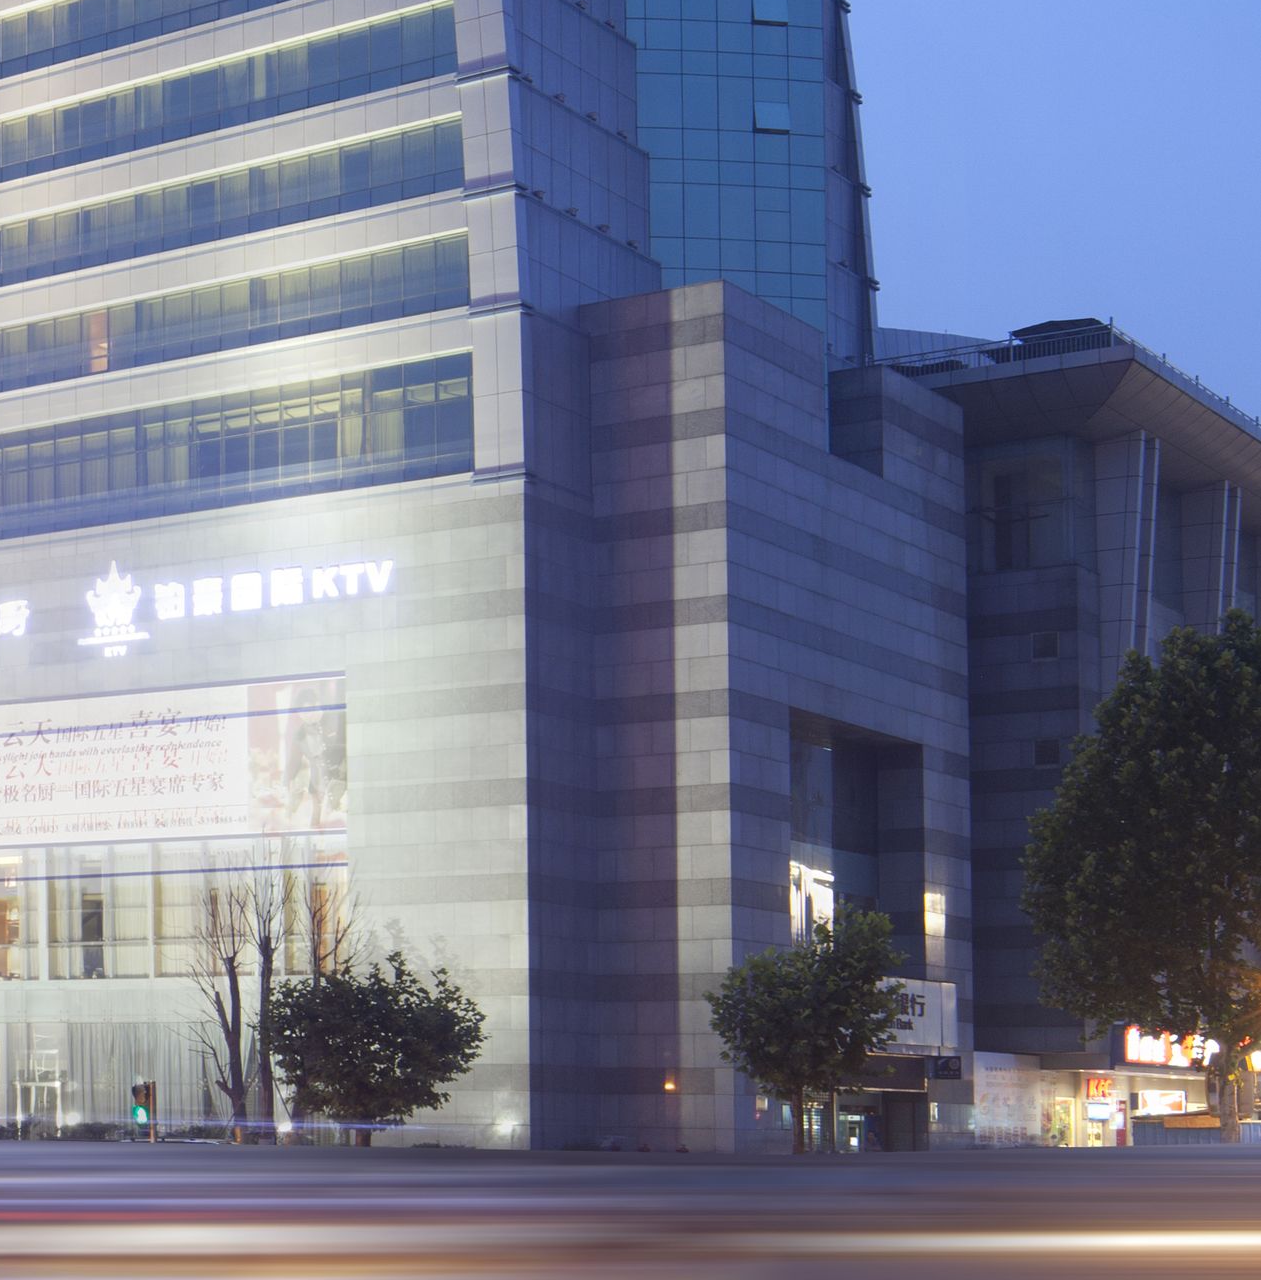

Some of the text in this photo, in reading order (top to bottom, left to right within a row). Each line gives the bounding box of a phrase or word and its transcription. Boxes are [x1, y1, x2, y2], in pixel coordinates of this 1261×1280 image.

[103, 645, 128, 658] KTV
[49, 748, 77, 758] hands
[79, 746, 98, 756] with
[1088, 1078, 1112, 1098] KFC
